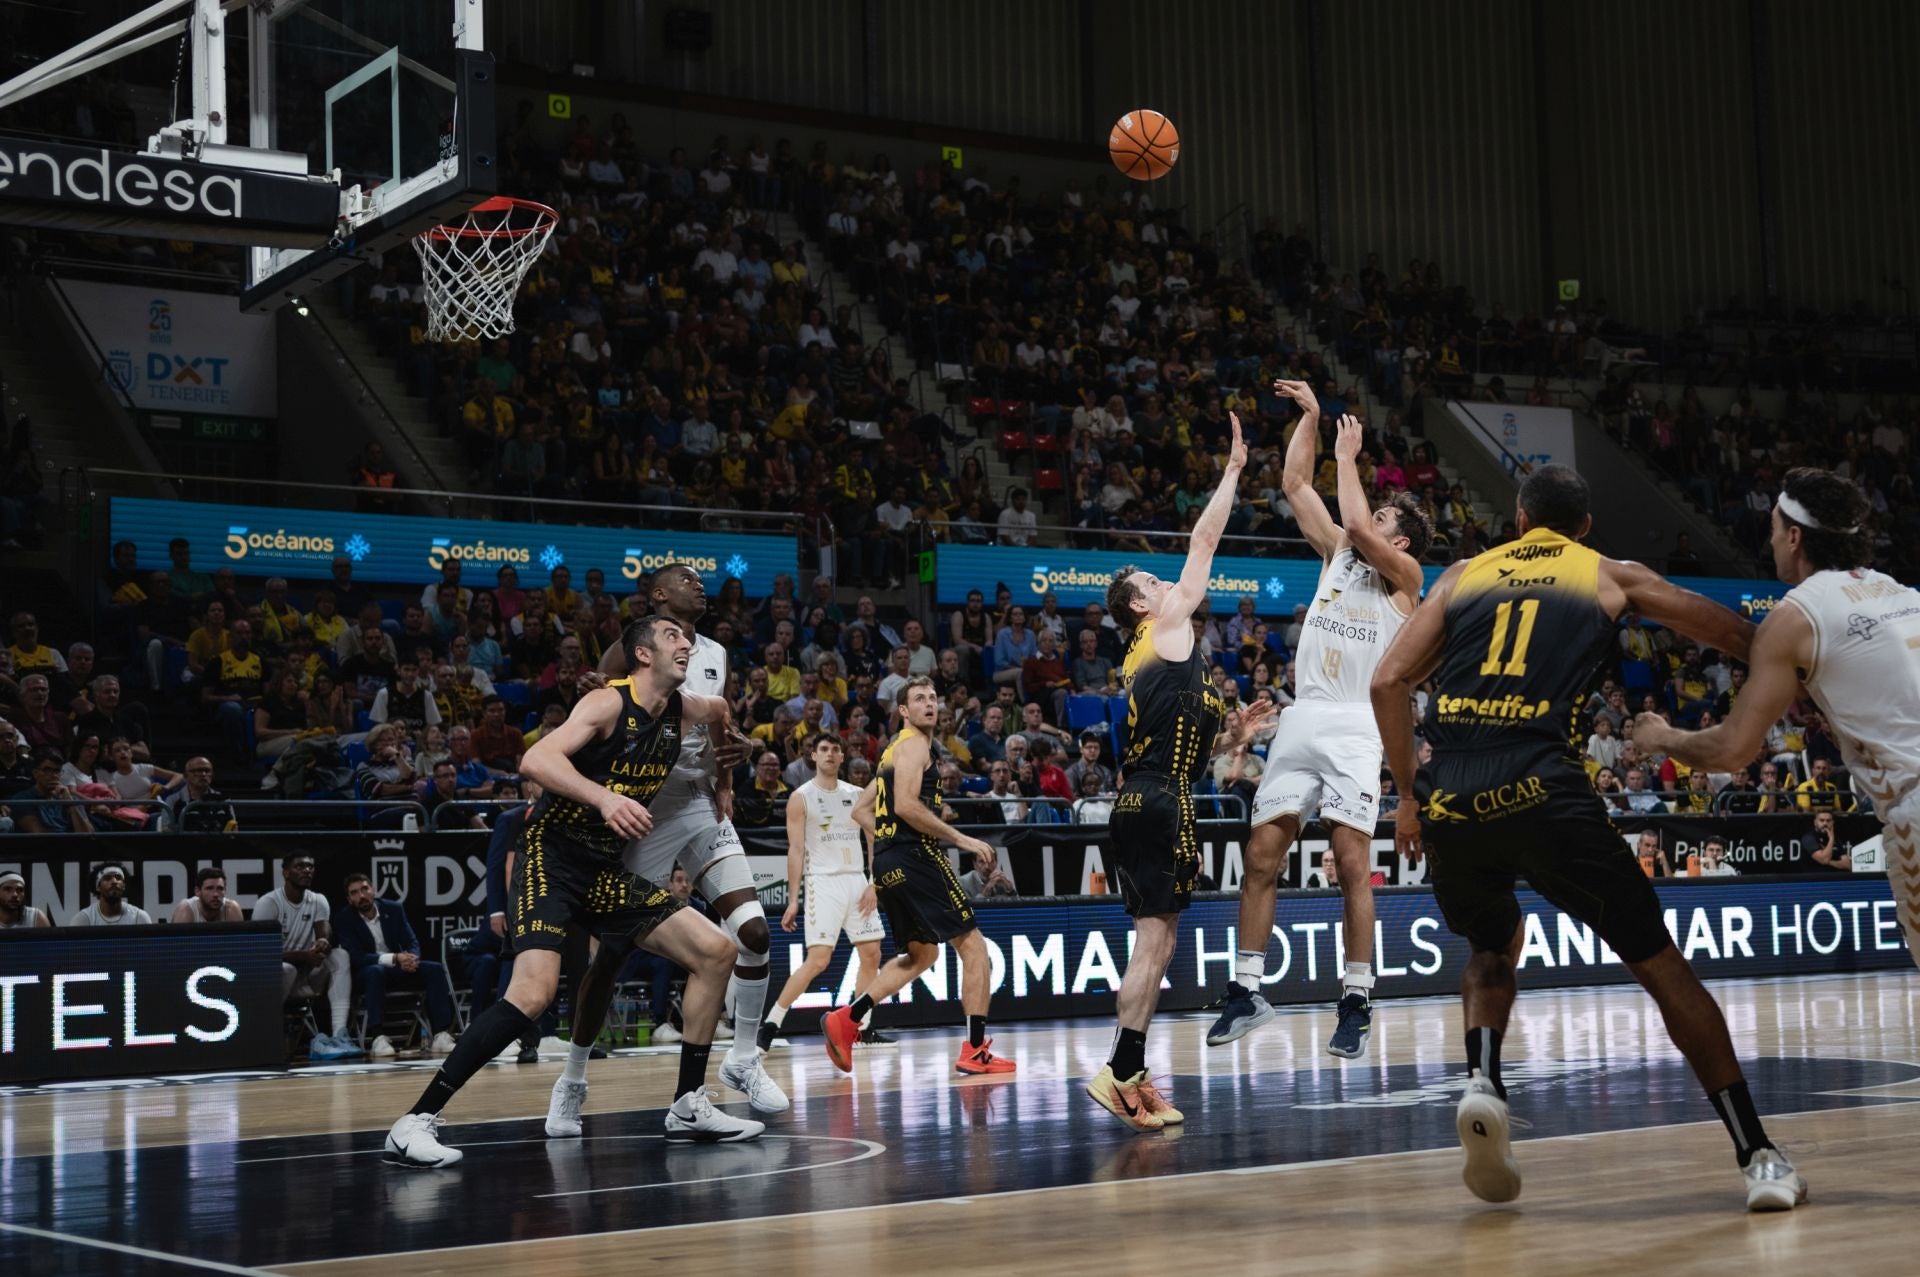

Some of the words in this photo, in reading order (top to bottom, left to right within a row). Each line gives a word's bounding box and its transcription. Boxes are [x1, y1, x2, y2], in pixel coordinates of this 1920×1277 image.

[147, 353, 229, 384] DXT
[147, 384, 231, 405] TENERIFE
[202, 421, 238, 435] EXIT
[1314, 616, 1366, 641] BURGOS
[1479, 598, 1541, 677] 11
[1437, 692, 1537, 720] tenerife
[632, 762, 668, 778] LAGUN
[1473, 776, 1548, 815] CICAR
[1763, 838, 1785, 862] de
[1771, 900, 1909, 956] HOTE
[789, 929, 1171, 1009] LANDMA
[1195, 916, 1443, 987] HOTLS
